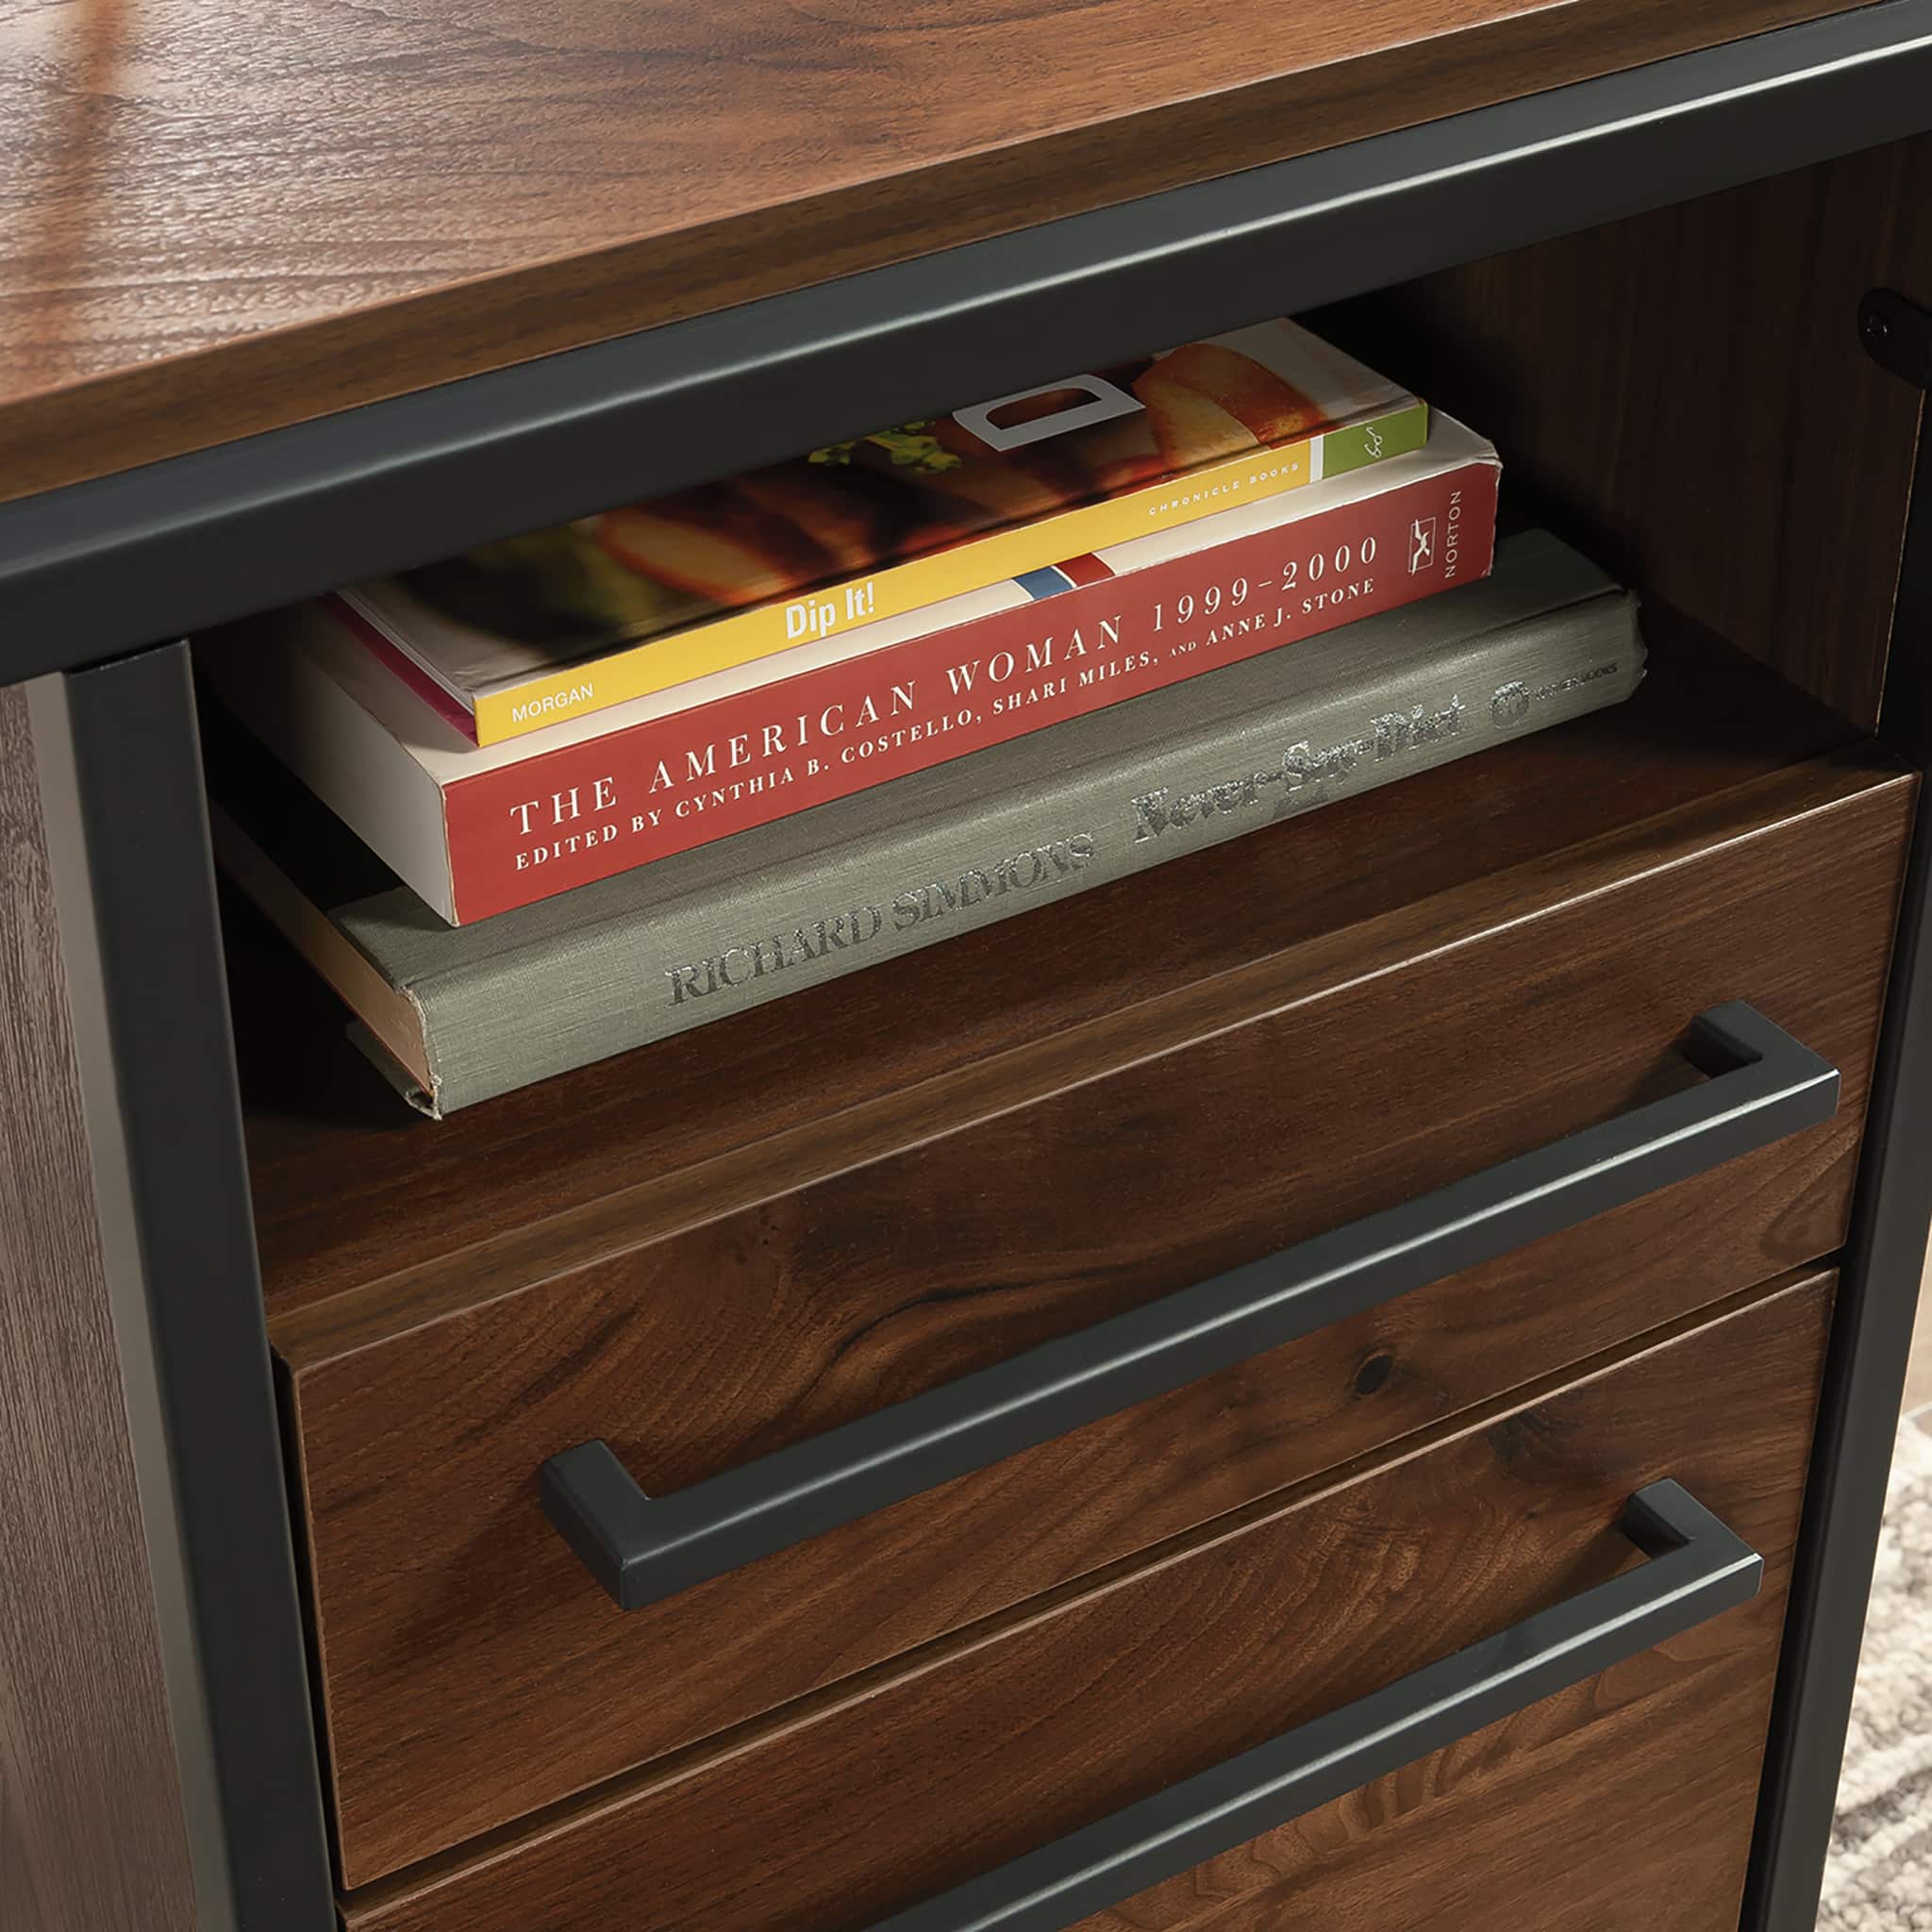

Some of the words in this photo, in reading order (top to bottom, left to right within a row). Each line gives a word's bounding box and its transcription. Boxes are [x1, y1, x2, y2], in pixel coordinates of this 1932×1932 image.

[1148, 479, 1241, 516] CHRONICLE
[1249, 462, 1300, 485] BOOKS
[1443, 490, 1462, 579] NORTON
[785, 599, 838, 641] Dip
[844, 580, 875, 622] It!
[508, 775, 619, 837] THE
[647, 679, 918, 795] AMERICAN
[943, 615, 1124, 697] WOMAN
[511, 682, 594, 724] MORGAN
[515, 824, 619, 872] EDITED
[631, 808, 662, 835] BY
[675, 766, 795, 819] CYNTHIA
[807, 758, 830, 777] B.
[841, 708, 983, 764] COSTELLO,
[991, 676, 1069, 716] SHARI
[1078, 650, 1160, 689] MILES,
[1168, 639, 1199, 659] AND
[1206, 613, 1268, 647] ANNE
[1273, 607, 1292, 628] J.
[1302, 577, 1376, 615] STONE
[664, 904, 883, 1007] RICHARD
[891, 832, 1096, 932] SIMMONS
